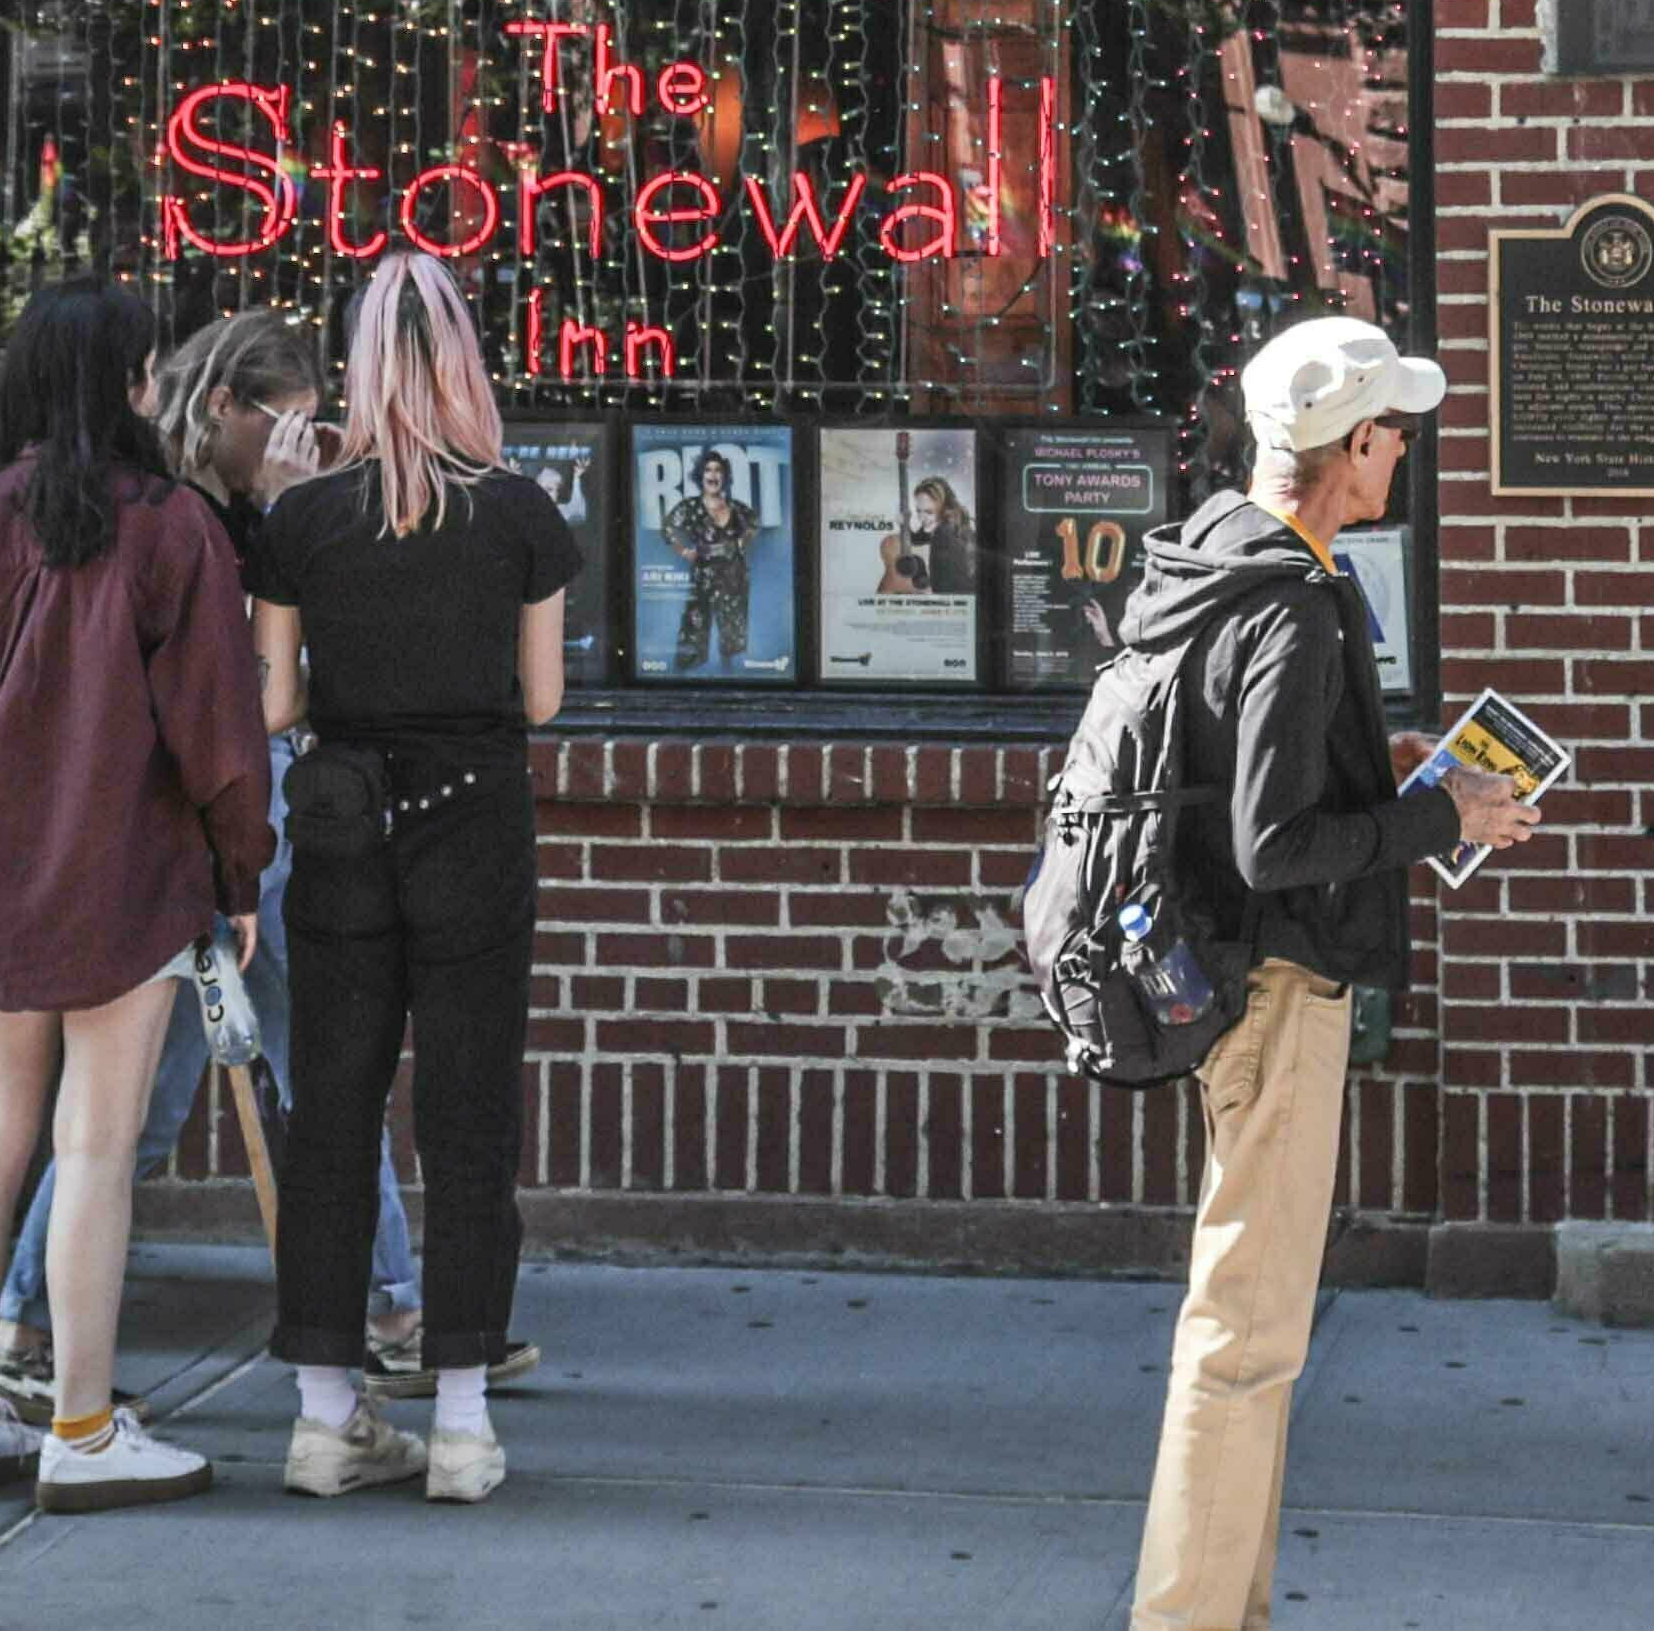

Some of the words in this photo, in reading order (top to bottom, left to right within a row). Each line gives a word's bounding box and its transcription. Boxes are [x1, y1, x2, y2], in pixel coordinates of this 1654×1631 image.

[505, 20, 709, 116] The
[162, 76, 1055, 262] Stonewall
[1526, 295, 1562, 313] The
[525, 284, 675, 382] Inn
[1535, 453, 1560, 465] New
[1565, 453, 1591, 465] York
[1034, 474, 1072, 487] TONY
[1077, 474, 1142, 488] AWARDS
[1065, 492, 1111, 504] PARTY
[829, 521, 894, 531] REYNOLDS
[1056, 517, 1125, 583] 10
